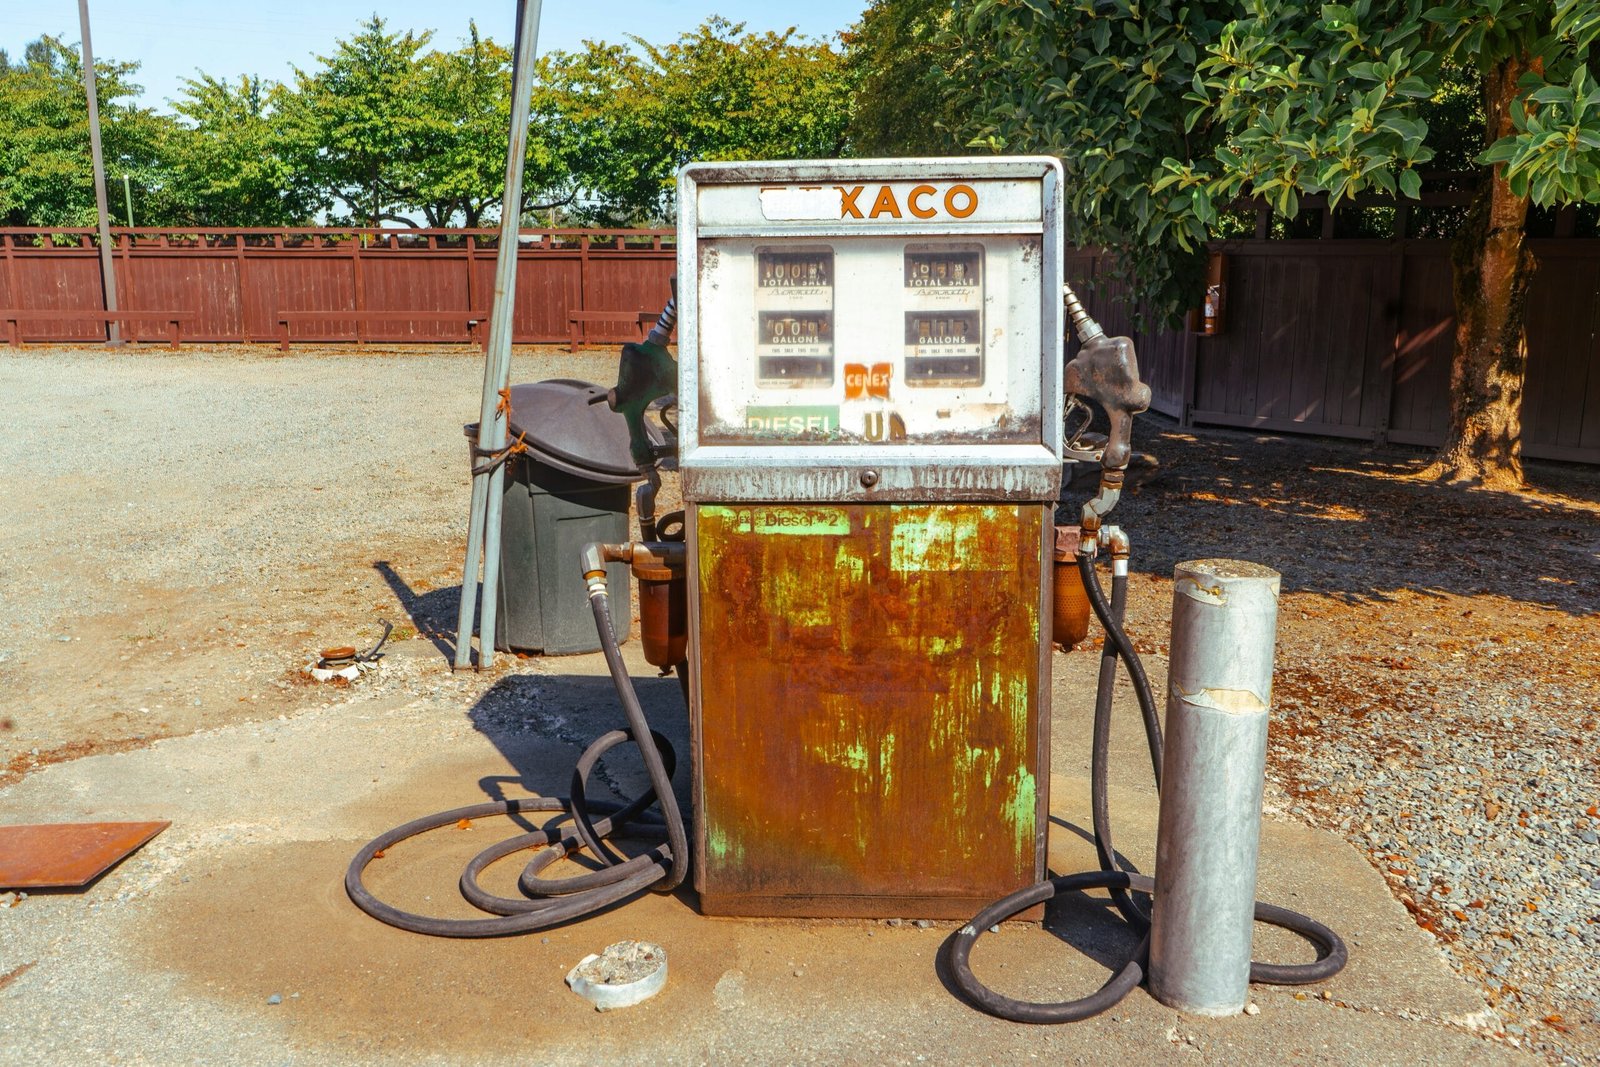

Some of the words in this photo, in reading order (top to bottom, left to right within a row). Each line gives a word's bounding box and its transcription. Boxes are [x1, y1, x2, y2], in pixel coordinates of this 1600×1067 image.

[761, 184, 978, 219] XACO
[772, 336, 819, 344] GALLONS
[919, 336, 966, 344] GALLONS
[846, 373, 890, 387] CENEX
[765, 513, 813, 527] Diesel
